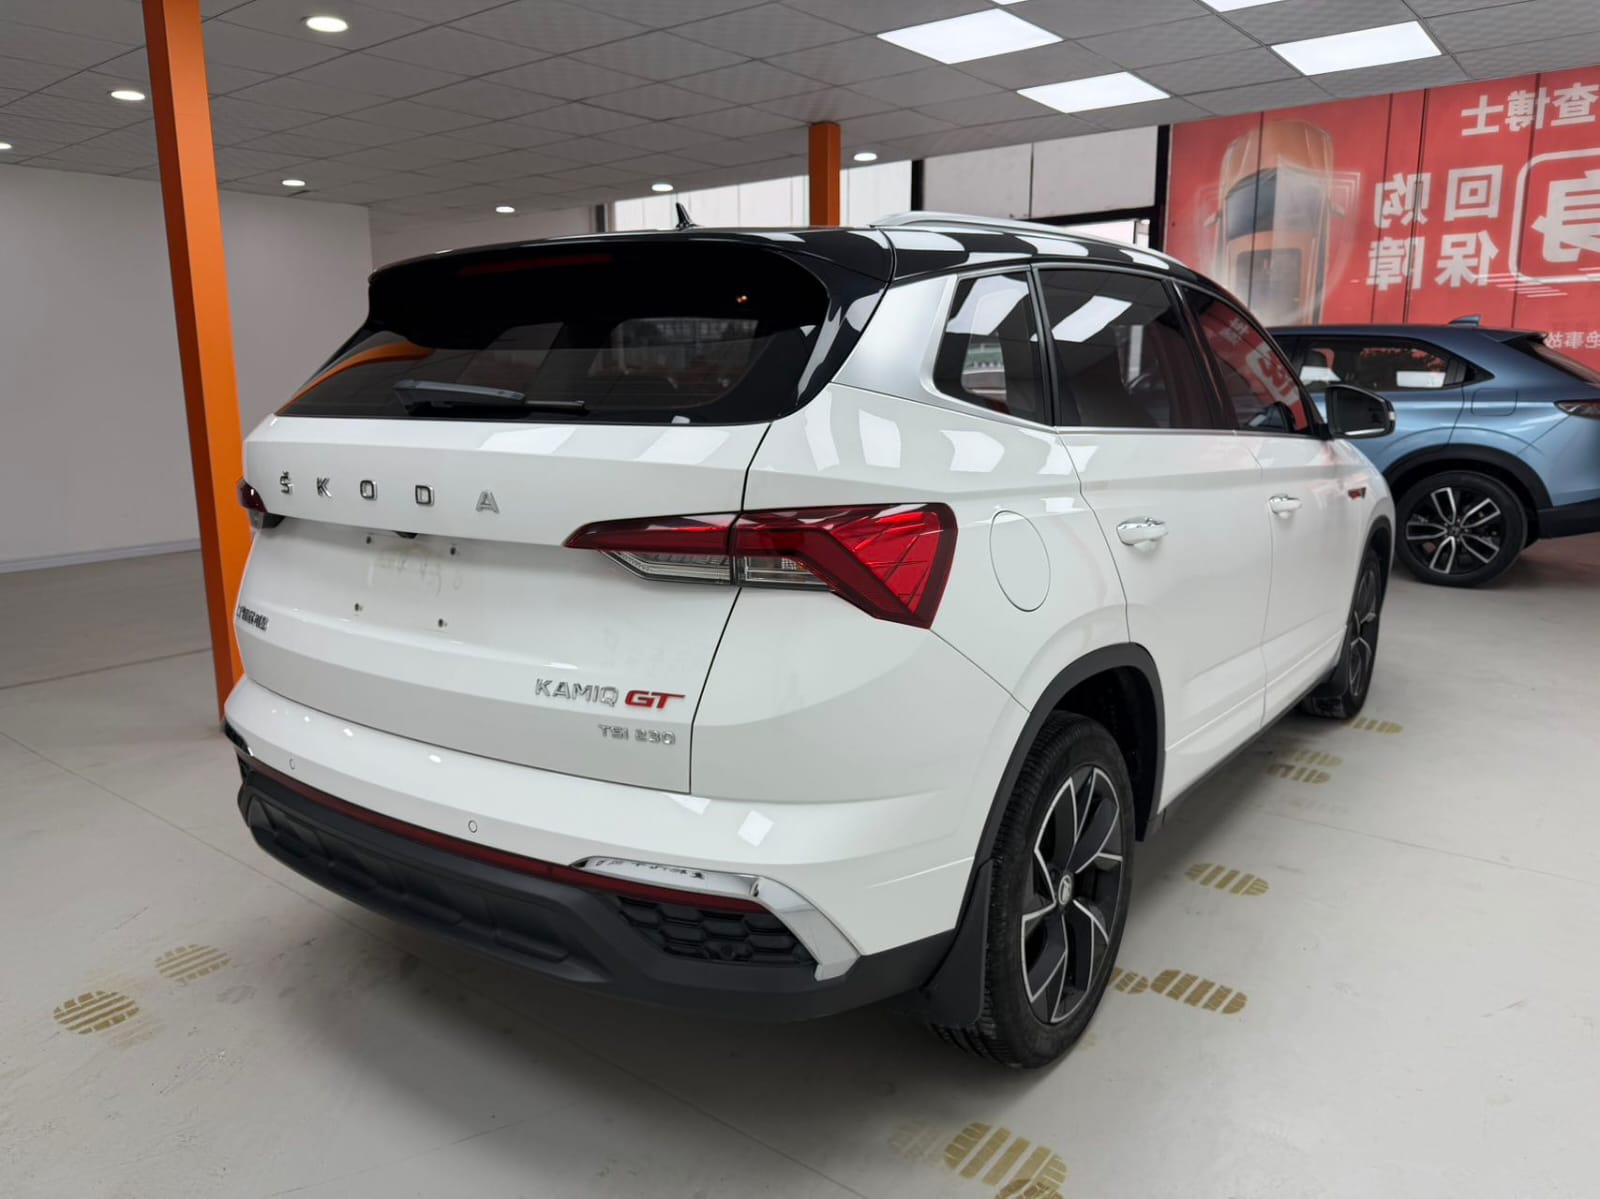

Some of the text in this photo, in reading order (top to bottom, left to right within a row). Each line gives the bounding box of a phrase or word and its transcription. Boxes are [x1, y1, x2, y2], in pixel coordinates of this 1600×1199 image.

[279, 470, 500, 514] ŠKODA
[535, 678, 686, 709] KAMIQ GT
[598, 724, 676, 746] TSI 230
